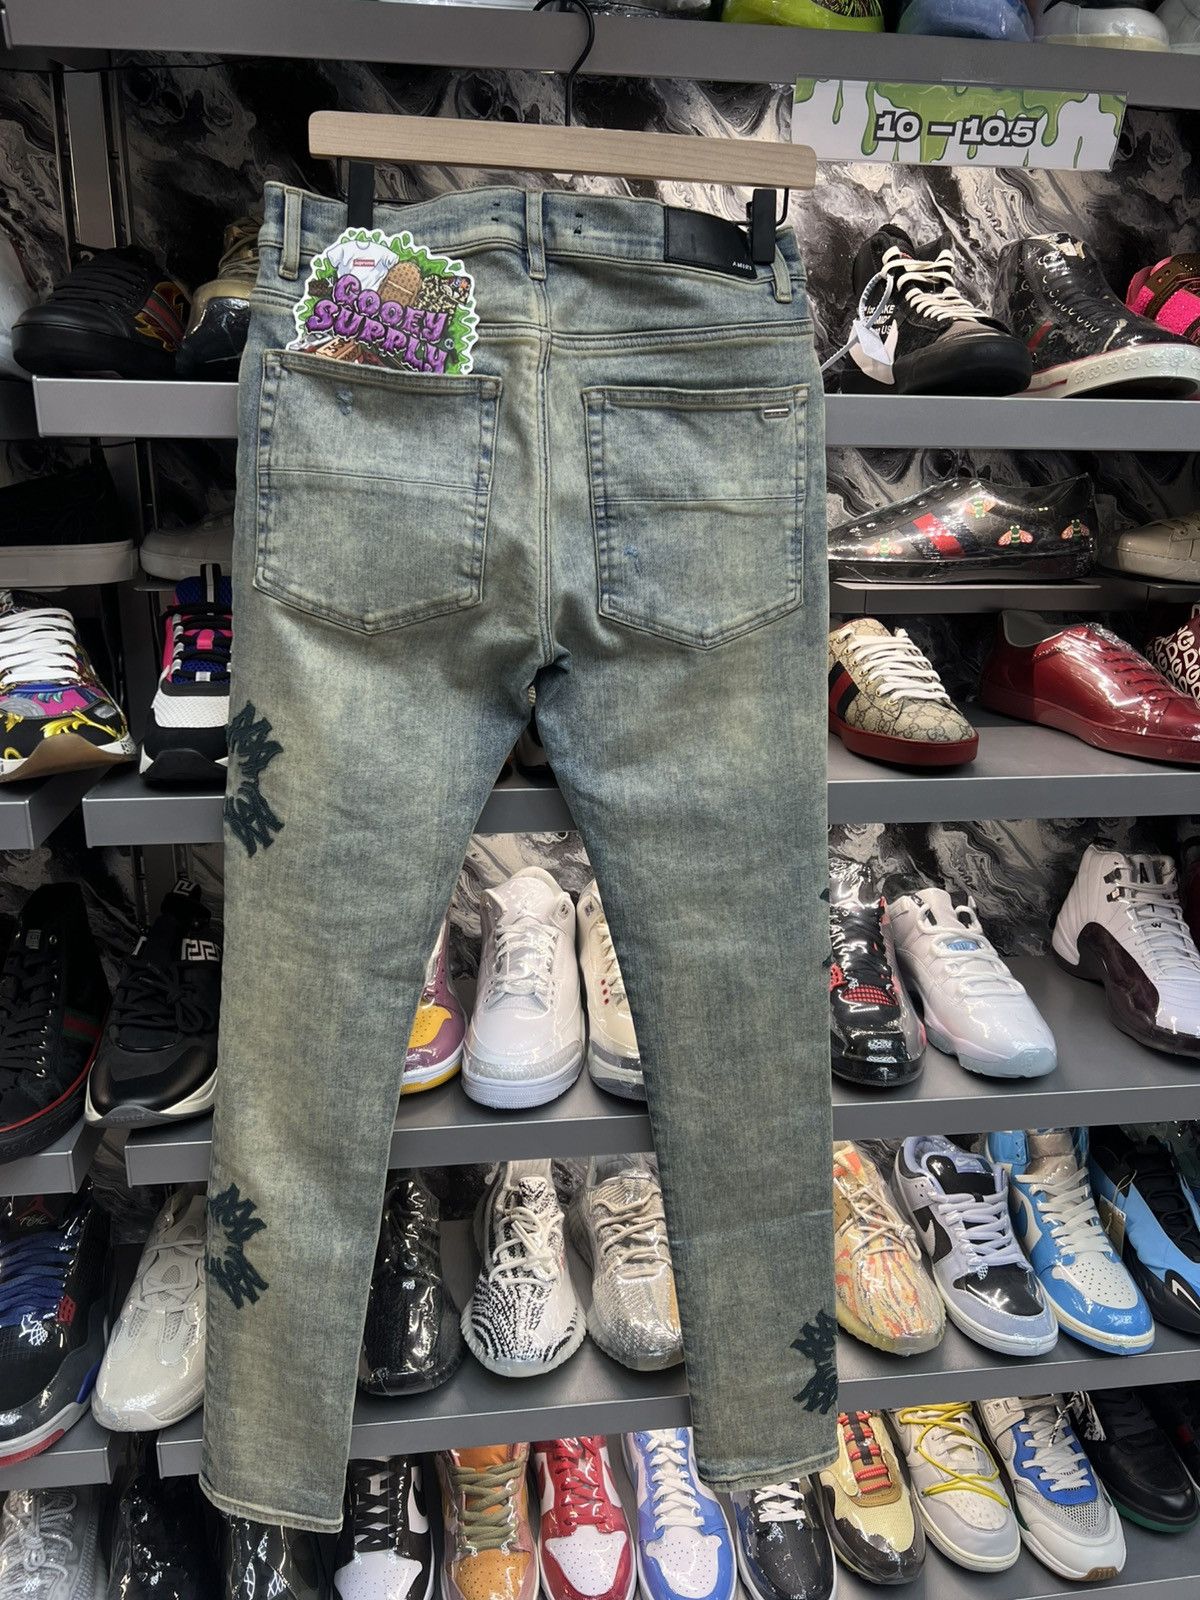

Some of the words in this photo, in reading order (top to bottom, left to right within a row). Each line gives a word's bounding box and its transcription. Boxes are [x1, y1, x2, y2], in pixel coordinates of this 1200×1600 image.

[874, 111, 922, 142] 10
[958, 115, 1039, 147] 10.5
[306, 300, 448, 374] SUPPLY
[333, 274, 448, 343] GOOEY
